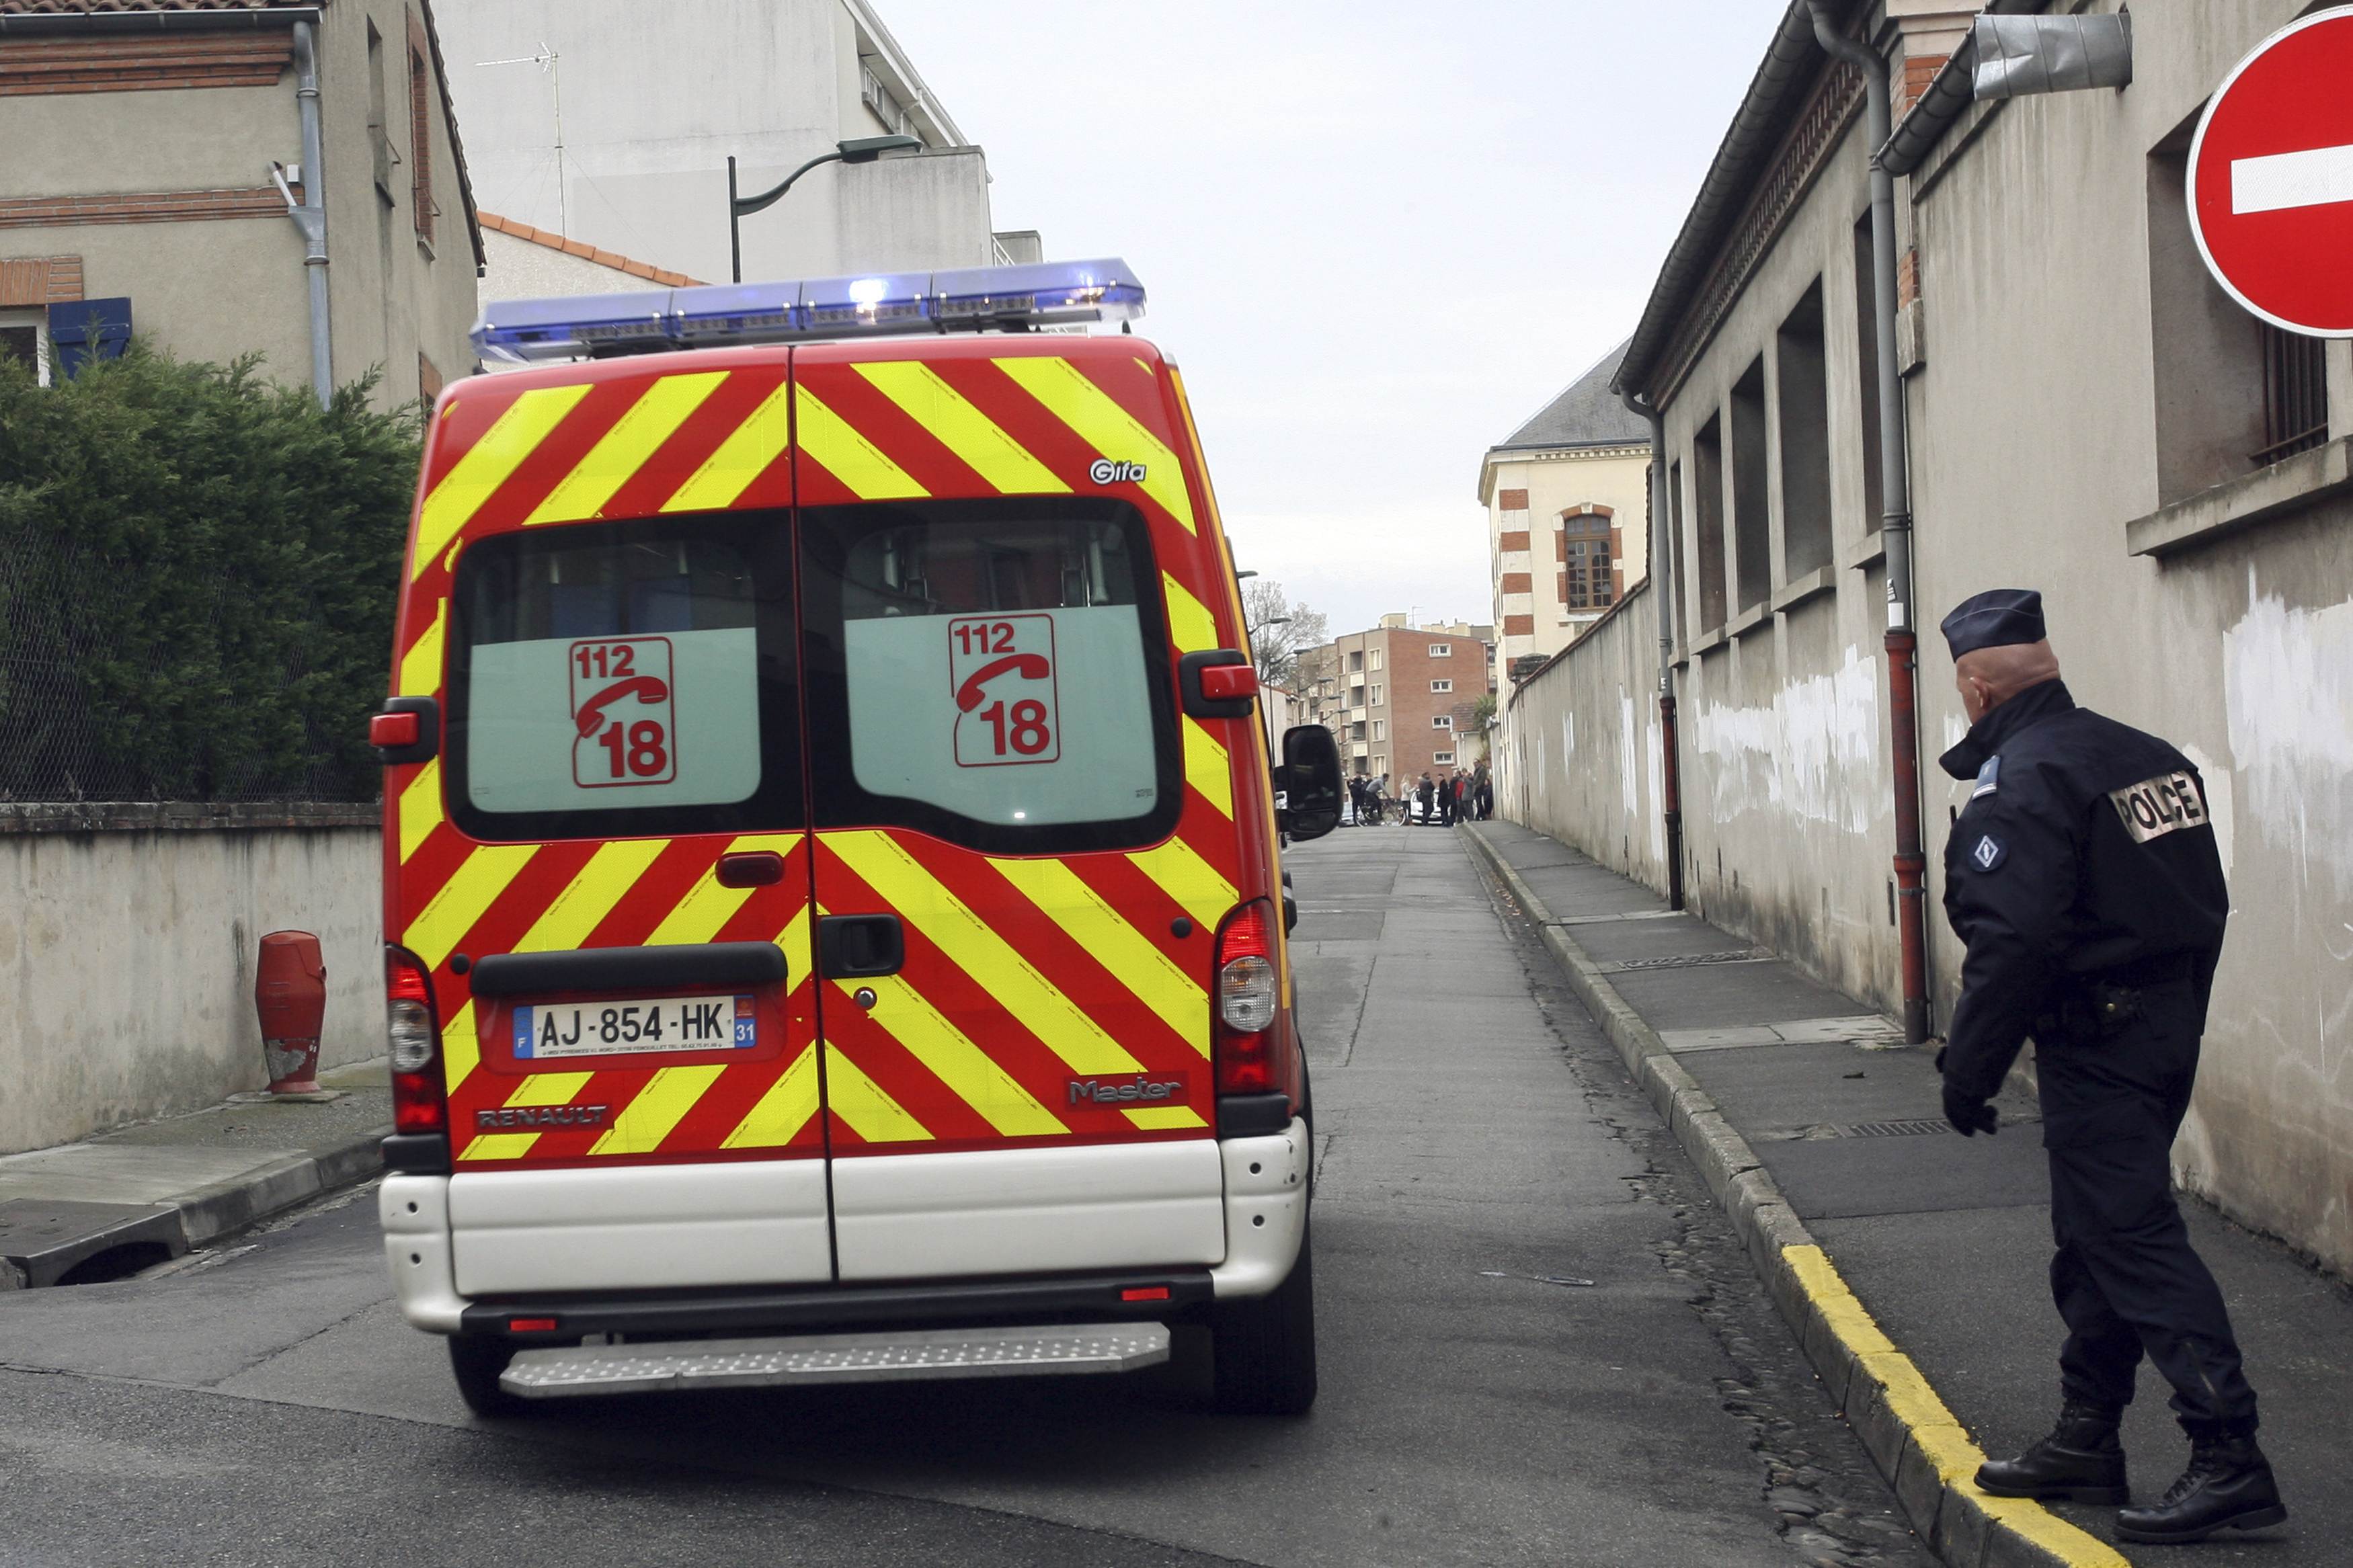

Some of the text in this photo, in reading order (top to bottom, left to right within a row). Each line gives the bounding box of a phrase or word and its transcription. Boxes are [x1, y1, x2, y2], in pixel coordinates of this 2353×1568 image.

[1090, 458, 1146, 485] Gifa
[955, 622, 1015, 655] 112
[576, 645, 635, 678] 112
[980, 699, 1050, 755] 18
[599, 720, 667, 778] 18
[2116, 780, 2201, 833] POLCE
[540, 1003, 723, 1046] AJ-854-HK
[736, 1024, 754, 1041] 31
[518, 1037, 526, 1048] F
[1070, 1077, 1181, 1104] Master
[477, 1105, 607, 1128] RENAULT
